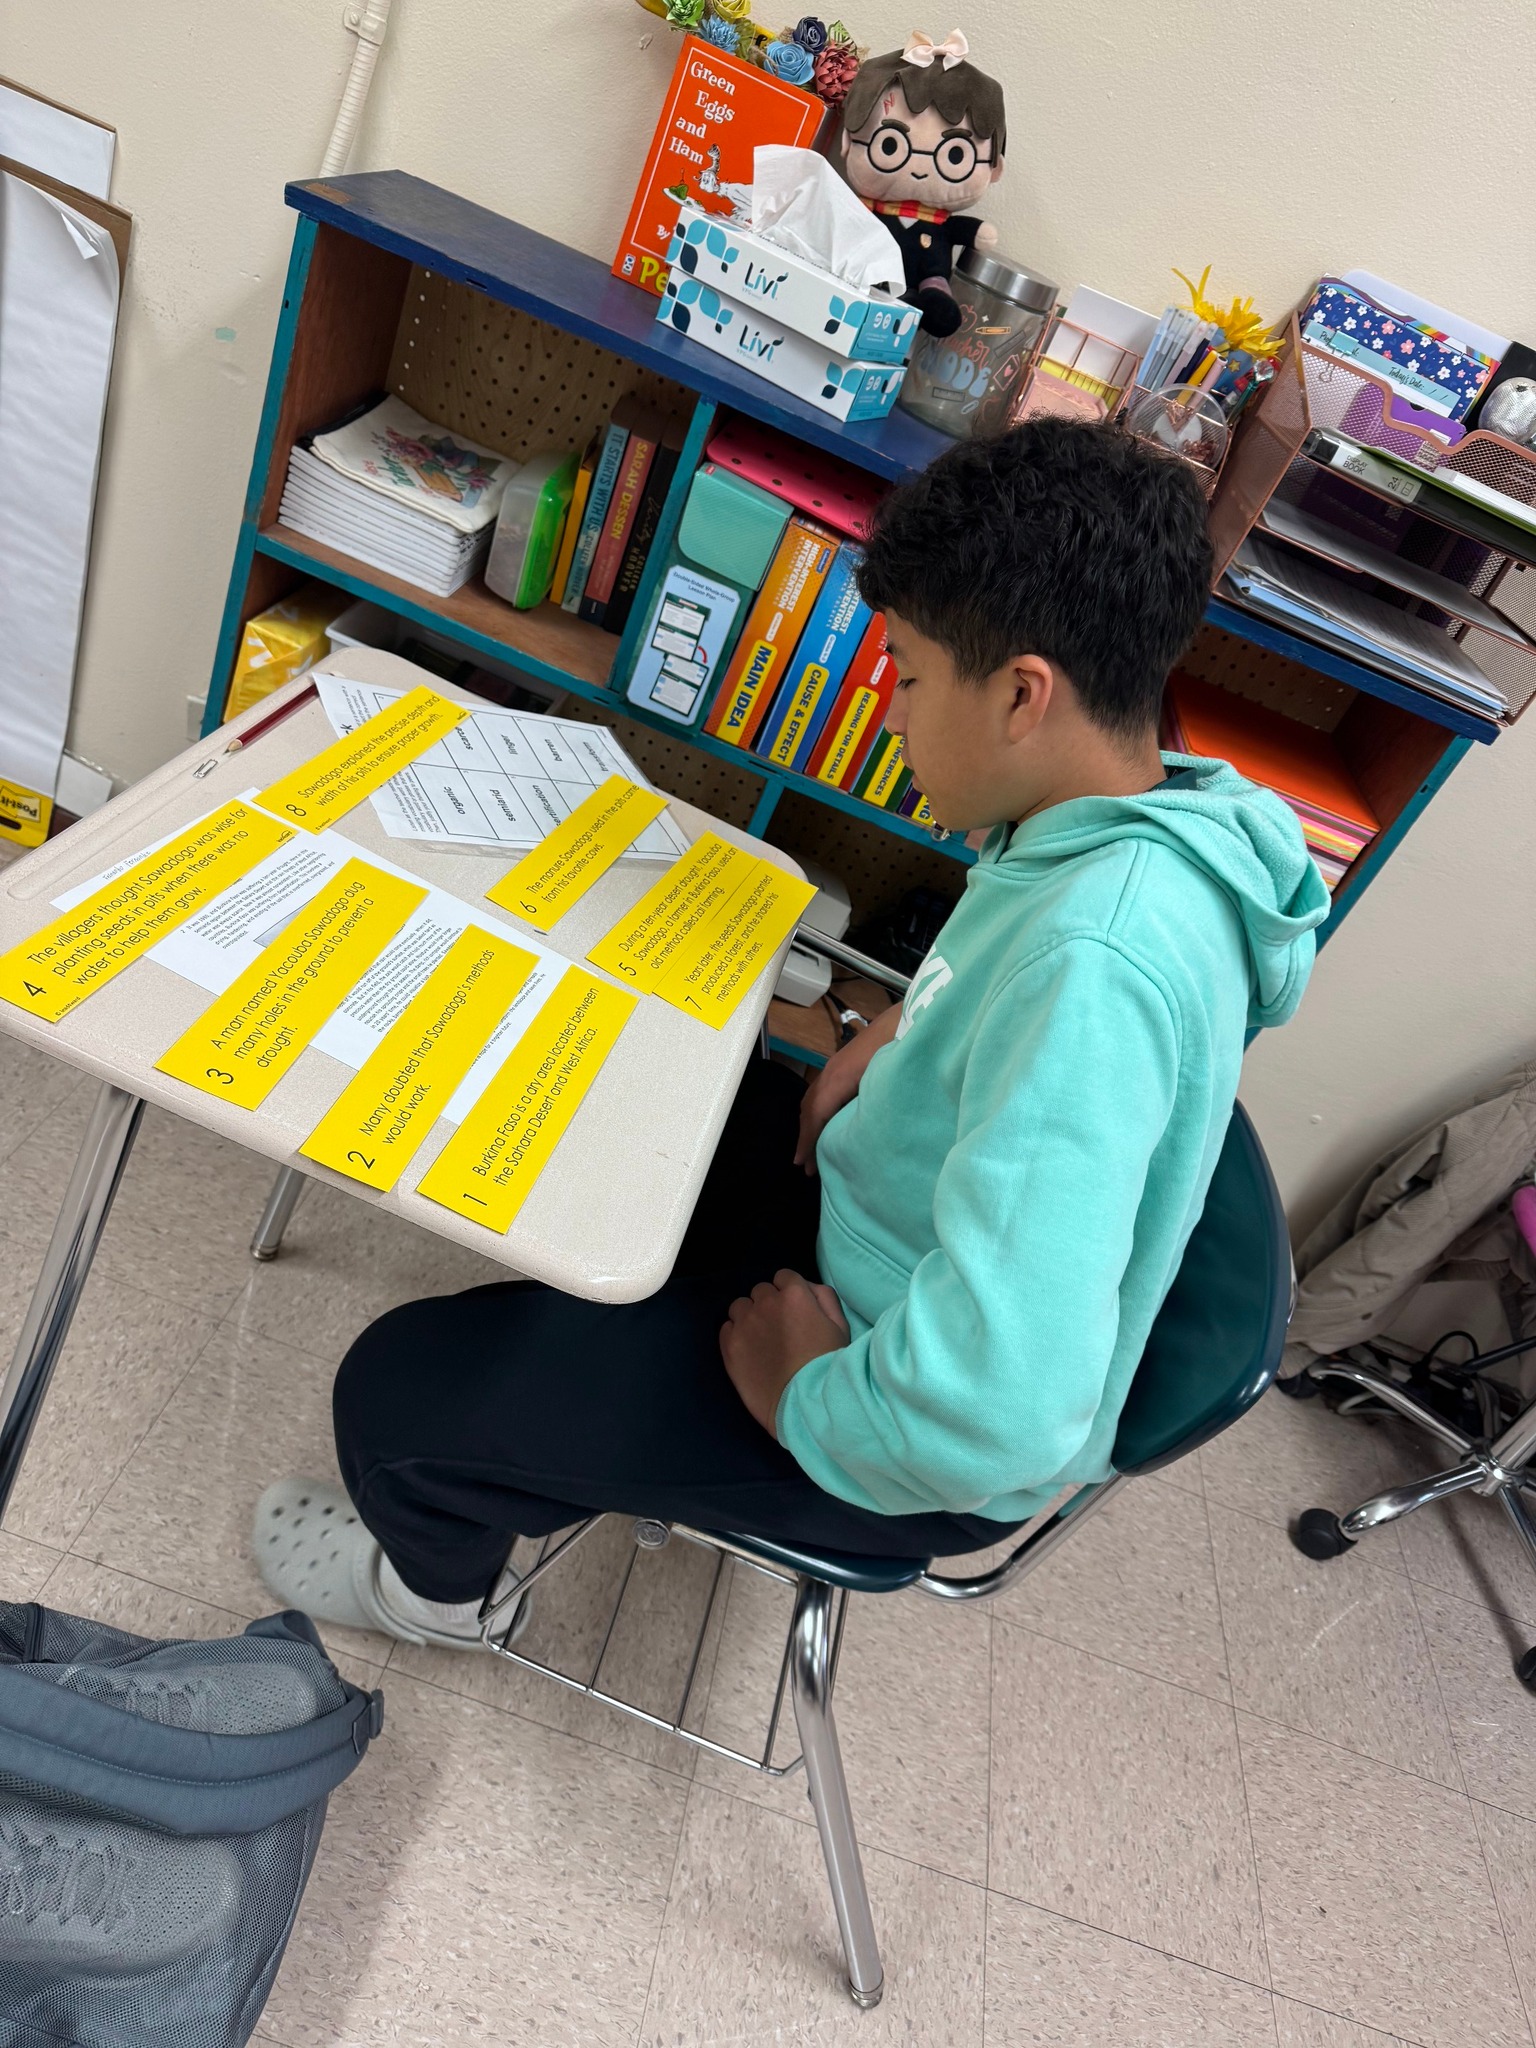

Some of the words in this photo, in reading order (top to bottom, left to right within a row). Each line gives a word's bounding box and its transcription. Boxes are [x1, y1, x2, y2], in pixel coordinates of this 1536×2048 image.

[690, 61, 736, 96] Green
[695, 90, 735, 124] Eggs
[676, 116, 706, 140] and
[669, 136, 704, 165] Ham
[656, 224, 670, 240] By
[744, 262, 788, 300] Livi
[739, 325, 784, 363] Livi
[1389, 366, 1408, 385] Today's
[1409, 377, 1425, 391] Date:
[610, 432, 624, 445] IT
[599, 446, 620, 486] STARTS
[624, 441, 648, 489] SARAH
[1342, 461, 1366, 475] BOOK
[1388, 476, 1399, 490] 24
[591, 487, 608, 516] WITH
[609, 491, 633, 540] DESSEN
[586, 516, 600, 533] US
[618, 544, 640, 594] HOOVER
[777, 538, 813, 609] INTERVENTION
[784, 541, 821, 613] HIGH-INTEREST
[742, 644, 772, 690] MAIN
[797, 667, 822, 709] CAUSE
[725, 689, 753, 729] IDEA
[793, 707, 805, 720] &
[849, 690, 871, 730] READING
[297, 767, 342, 798] Sawadogo
[339, 741, 376, 769] explained
[370, 734, 387, 745] the
[384, 718, 409, 738] precise
[406, 704, 428, 720] depth
[424, 694, 440, 707] and
[396, 728, 420, 747] proper
[500, 734, 518, 755] linger
[544, 738, 563, 762] barren
[775, 718, 801, 762] EFFECT
[841, 728, 854, 747] FOR
[365, 760, 379, 768] to
[375, 744, 400, 762] ensure
[825, 746, 846, 780] DETAILS
[342, 775, 359, 784] his
[355, 766, 371, 778] pits
[874, 745, 902, 796] INFERENCES
[315, 789, 340, 806] width
[337, 781, 349, 790] of
[1, 796, 38, 817] Post-it
[285, 804, 306, 816] 8
[444, 786, 466, 815] organic
[489, 789, 516, 822] semiarid
[532, 785, 562, 825] ertification
[525, 881, 543, 893] The
[539, 859, 565, 883] manure
[558, 831, 593, 861] Sawadogo
[589, 817, 605, 832] used
[598, 813, 610, 821] in
[604, 806, 618, 815] the
[614, 797, 626, 809] pits
[622, 784, 639, 799] came
[696, 843, 721, 865] Yacouba
[26, 947, 56, 964] The
[53, 913, 103, 946] villagers
[96, 881, 144, 914] thought
[138, 845, 196, 884] Sawadogo
[192, 831, 216, 846] was
[212, 818, 235, 832] wise
[229, 808, 247, 819] for
[541, 887, 561, 903] from
[554, 878, 569, 889] his
[562, 858, 589, 880] favorite
[664, 884, 683, 903] desert
[51, 938, 106, 977] planting
[100, 914, 135, 939] seeds
[127, 906, 147, 916] in
[142, 892, 165, 909] pits
[160, 871, 193, 893] when
[186, 853, 217, 873] there
[213, 839, 236, 853] was
[232, 830, 248, 841] no
[519, 900, 536, 913] 6
[641, 901, 668, 926] ten-year
[72, 957, 111, 984] water
[104, 948, 124, 958] to
[117, 928, 149, 948] help
[143, 907, 178, 929] them
[174, 886, 206, 909] grow.
[618, 929, 644, 951] During
[638, 924, 647, 932] a
[683, 965, 704, 983] Years
[709, 939, 723, 952] the
[718, 923, 736, 942] seeds
[729, 894, 757, 925] Sawadogo
[753, 874, 772, 897] planted
[210, 1039, 226, 1049] A
[220, 1014, 247, 1039] man
[241, 978, 277, 1015] named
[268, 939, 312, 978] Yacouba
[304, 897, 348, 940] Sawadogo
[343, 881, 365, 897] dug
[618, 962, 636, 975] 5
[23, 980, 46, 996] 4
[233, 1027, 266, 1059] many
[255, 1002, 286, 1028] holes
[276, 993, 295, 1003] in
[286, 976, 308, 993] the
[303, 943, 334, 978] ground
[326, 935, 342, 945] to
[337, 903, 368, 937] prevent
[716, 972, 740, 1002] methods
[735, 960, 749, 973] with
[568, 987, 598, 1023] between
[684, 995, 701, 1010] 7
[255, 1026, 297, 1067] drought.
[358, 1102, 391, 1136] Many
[383, 1056, 420, 1102] doubted
[411, 1036, 434, 1058] that
[425, 983, 471, 1038] Sawadogo's
[465, 949, 494, 985] methods
[547, 1021, 576, 1057] located
[206, 1068, 233, 1084] 3
[536, 1056, 555, 1078] area
[520, 1095, 531, 1104] a
[525, 1078, 543, 1094] dry
[382, 1108, 412, 1143] would
[405, 1084, 431, 1109] work.
[492, 1166, 513, 1185] the
[504, 1128, 536, 1166] Sahara
[527, 1094, 555, 1127] Desert
[550, 1074, 567, 1095] and
[559, 1052, 580, 1074] West
[574, 1028, 597, 1054] Africa.
[511, 1103, 526, 1113] is
[496, 1113, 520, 1137] Faso
[347, 1151, 375, 1169] 2
[472, 1136, 505, 1176] Burkina
[463, 1193, 487, 1205] 1
